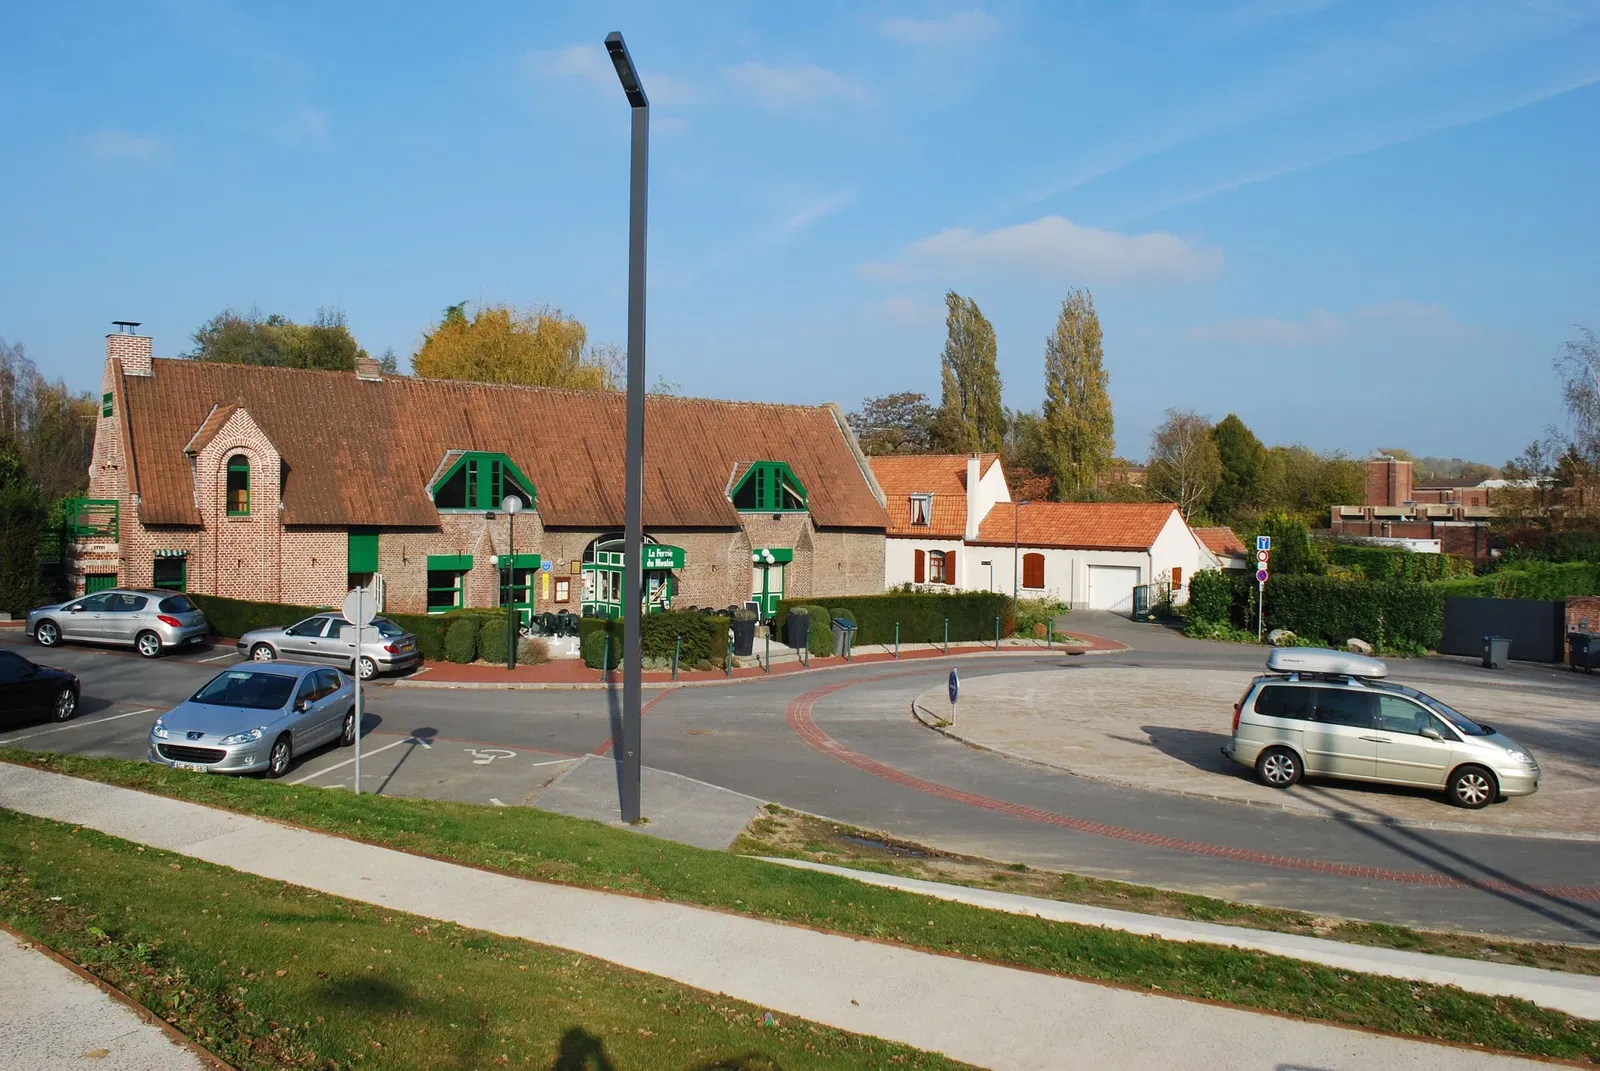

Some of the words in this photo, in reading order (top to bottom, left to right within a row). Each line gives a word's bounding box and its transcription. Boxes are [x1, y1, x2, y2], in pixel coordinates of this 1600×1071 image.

[648, 549, 655, 557] La
[656, 548, 673, 557] Ferme
[646, 558, 654, 567] du
[655, 558, 674, 567] Moulin
